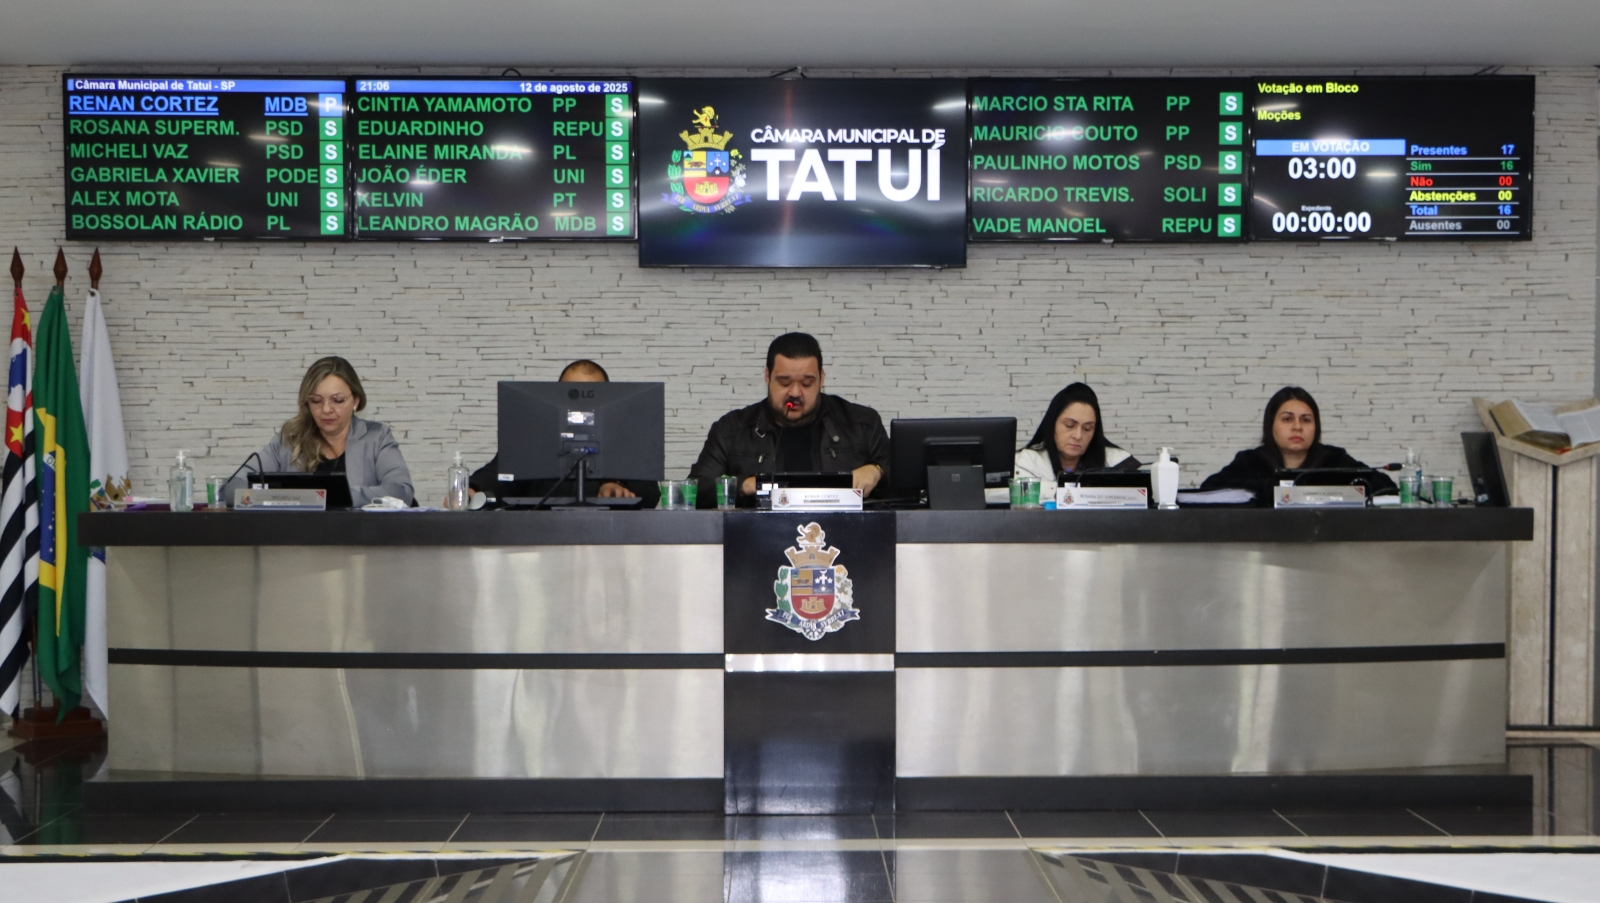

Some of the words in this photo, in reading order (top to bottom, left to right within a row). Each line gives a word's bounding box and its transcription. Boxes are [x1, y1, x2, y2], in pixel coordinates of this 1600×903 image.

[75, 80, 115, 90] Câmara
[118, 80, 168, 92] Municipal
[170, 81, 184, 90] de
[221, 81, 235, 90] SP
[360, 82, 389, 91] 21:06
[520, 83, 532, 92] 12
[534, 83, 547, 92] de
[550, 83, 585, 94] agosto
[588, 83, 600, 92] de
[603, 83, 628, 92] 2025
[1258, 83, 1303, 95] Votação
[1306, 85, 1323, 93] em
[1326, 82, 1359, 93] Bloco
[69, 96, 135, 112] RENAN
[140, 96, 219, 112] CORTEZ
[265, 96, 308, 113] MDB
[325, 97, 337, 112] P
[357, 97, 419, 112] CINTIA
[424, 97, 532, 113] YAMAMOTO
[553, 98, 576, 112] PP
[611, 97, 623, 114] S
[974, 96, 1048, 112] MARCIO
[1053, 96, 1088, 112] STA
[1093, 96, 1134, 112] RITA
[1166, 97, 1190, 111] PP
[1225, 96, 1238, 112] S
[1258, 110, 1301, 122] Moções
[70, 120, 150, 135] ROSANA
[154, 120, 240, 136] SUPERM.
[265, 121, 303, 136] PSD
[325, 120, 337, 136] S
[358, 121, 484, 136] EDUARDINHO
[553, 122, 603, 136] REPU
[611, 121, 623, 137] S
[751, 125, 825, 144] CÂMARA
[827, 128, 919, 144] MUNICIPAL
[922, 128, 946, 144] DE
[973, 126, 1065, 141] MAURICIO
[1072, 126, 1138, 141] COUTO
[1166, 126, 1190, 140] PP
[1225, 125, 1237, 142] S
[70, 144, 147, 159] MICHELI
[152, 144, 188, 159] VAZ
[266, 144, 304, 160] PSD
[325, 144, 338, 160] S
[358, 144, 428, 159] ELAINE
[434, 145, 522, 160] MIRANDA
[553, 145, 576, 160] PL
[611, 145, 623, 160] S
[1292, 142, 1309, 152] EM
[1312, 140, 1370, 154] VOTAÇÃO
[1410, 145, 1467, 155] Presentes
[1501, 144, 1514, 154] 17
[973, 155, 1067, 170] PAULINHO
[1073, 155, 1140, 170] MOTOS
[1164, 155, 1201, 170] PSD
[1224, 154, 1237, 170] S
[1288, 157, 1356, 179] 03:00
[1411, 161, 1431, 171] Sim
[1500, 161, 1514, 170] 16
[71, 167, 168, 183] GABRIELA
[172, 168, 240, 183] XAVIER
[266, 168, 318, 183] PODE
[325, 168, 338, 184] S
[357, 165, 410, 183] JOÃO
[416, 164, 467, 183] ÉDER
[553, 169, 585, 184] UNI
[611, 168, 624, 184] S
[750, 142, 946, 201] TATUÍ
[1410, 177, 1433, 187] Não
[1498, 176, 1512, 186] 00
[71, 191, 120, 206] ALEX
[126, 191, 179, 206] MOTA
[267, 192, 298, 207] UNI
[325, 192, 338, 208] S
[358, 193, 424, 207] KELVIN
[553, 193, 576, 208] PT
[612, 193, 624, 208] S
[973, 187, 1058, 202] RICARDO
[1064, 187, 1134, 202] TREVIS.
[1164, 187, 1206, 202] SOLI
[1224, 186, 1236, 203] S
[1410, 191, 1476, 203] Abstenções
[1498, 191, 1512, 201] 00
[1410, 206, 1438, 215] Total
[1498, 206, 1511, 215] 16
[72, 215, 177, 230] BOSSOLAN
[183, 212, 243, 231] RÁDIO
[267, 215, 290, 230] PL
[326, 215, 338, 231] S
[358, 216, 449, 231] LEANDRO
[455, 213, 539, 232] MAGRÃO
[555, 216, 597, 231] MDB
[612, 216, 624, 232] S
[973, 218, 1021, 233] VADE
[1027, 218, 1106, 233] MANOEL
[1162, 218, 1212, 233] REPU
[1223, 218, 1236, 234] S
[1272, 212, 1371, 232] 00:00:00
[1409, 220, 1462, 230] Ausentes
[1496, 220, 1510, 230] 00
